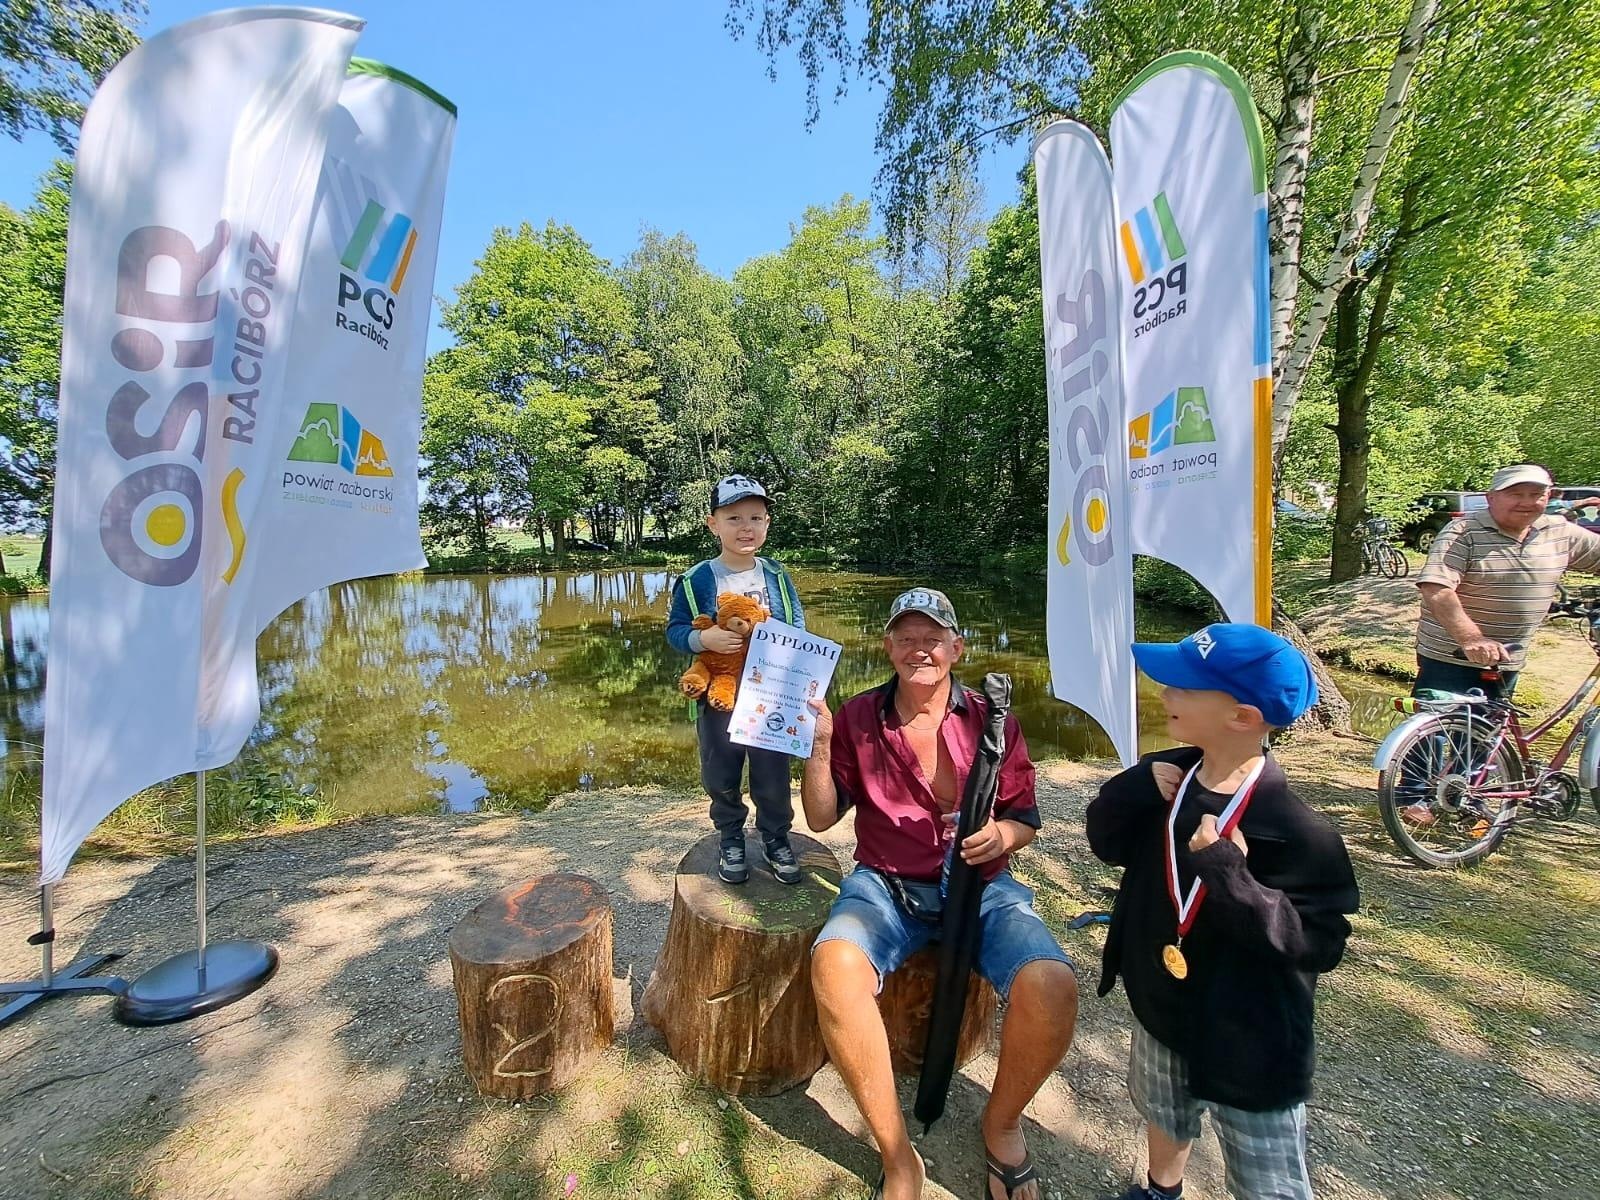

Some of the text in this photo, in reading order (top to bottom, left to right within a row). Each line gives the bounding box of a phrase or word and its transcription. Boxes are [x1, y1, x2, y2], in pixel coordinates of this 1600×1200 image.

[338, 272, 396, 330] PCS
[222, 230, 281, 445] RACIBÓRZ
[335, 311, 389, 351] Racibórz
[282, 472, 393, 502] powiat raciborski
[756, 629, 828, 657] DYPLOM
